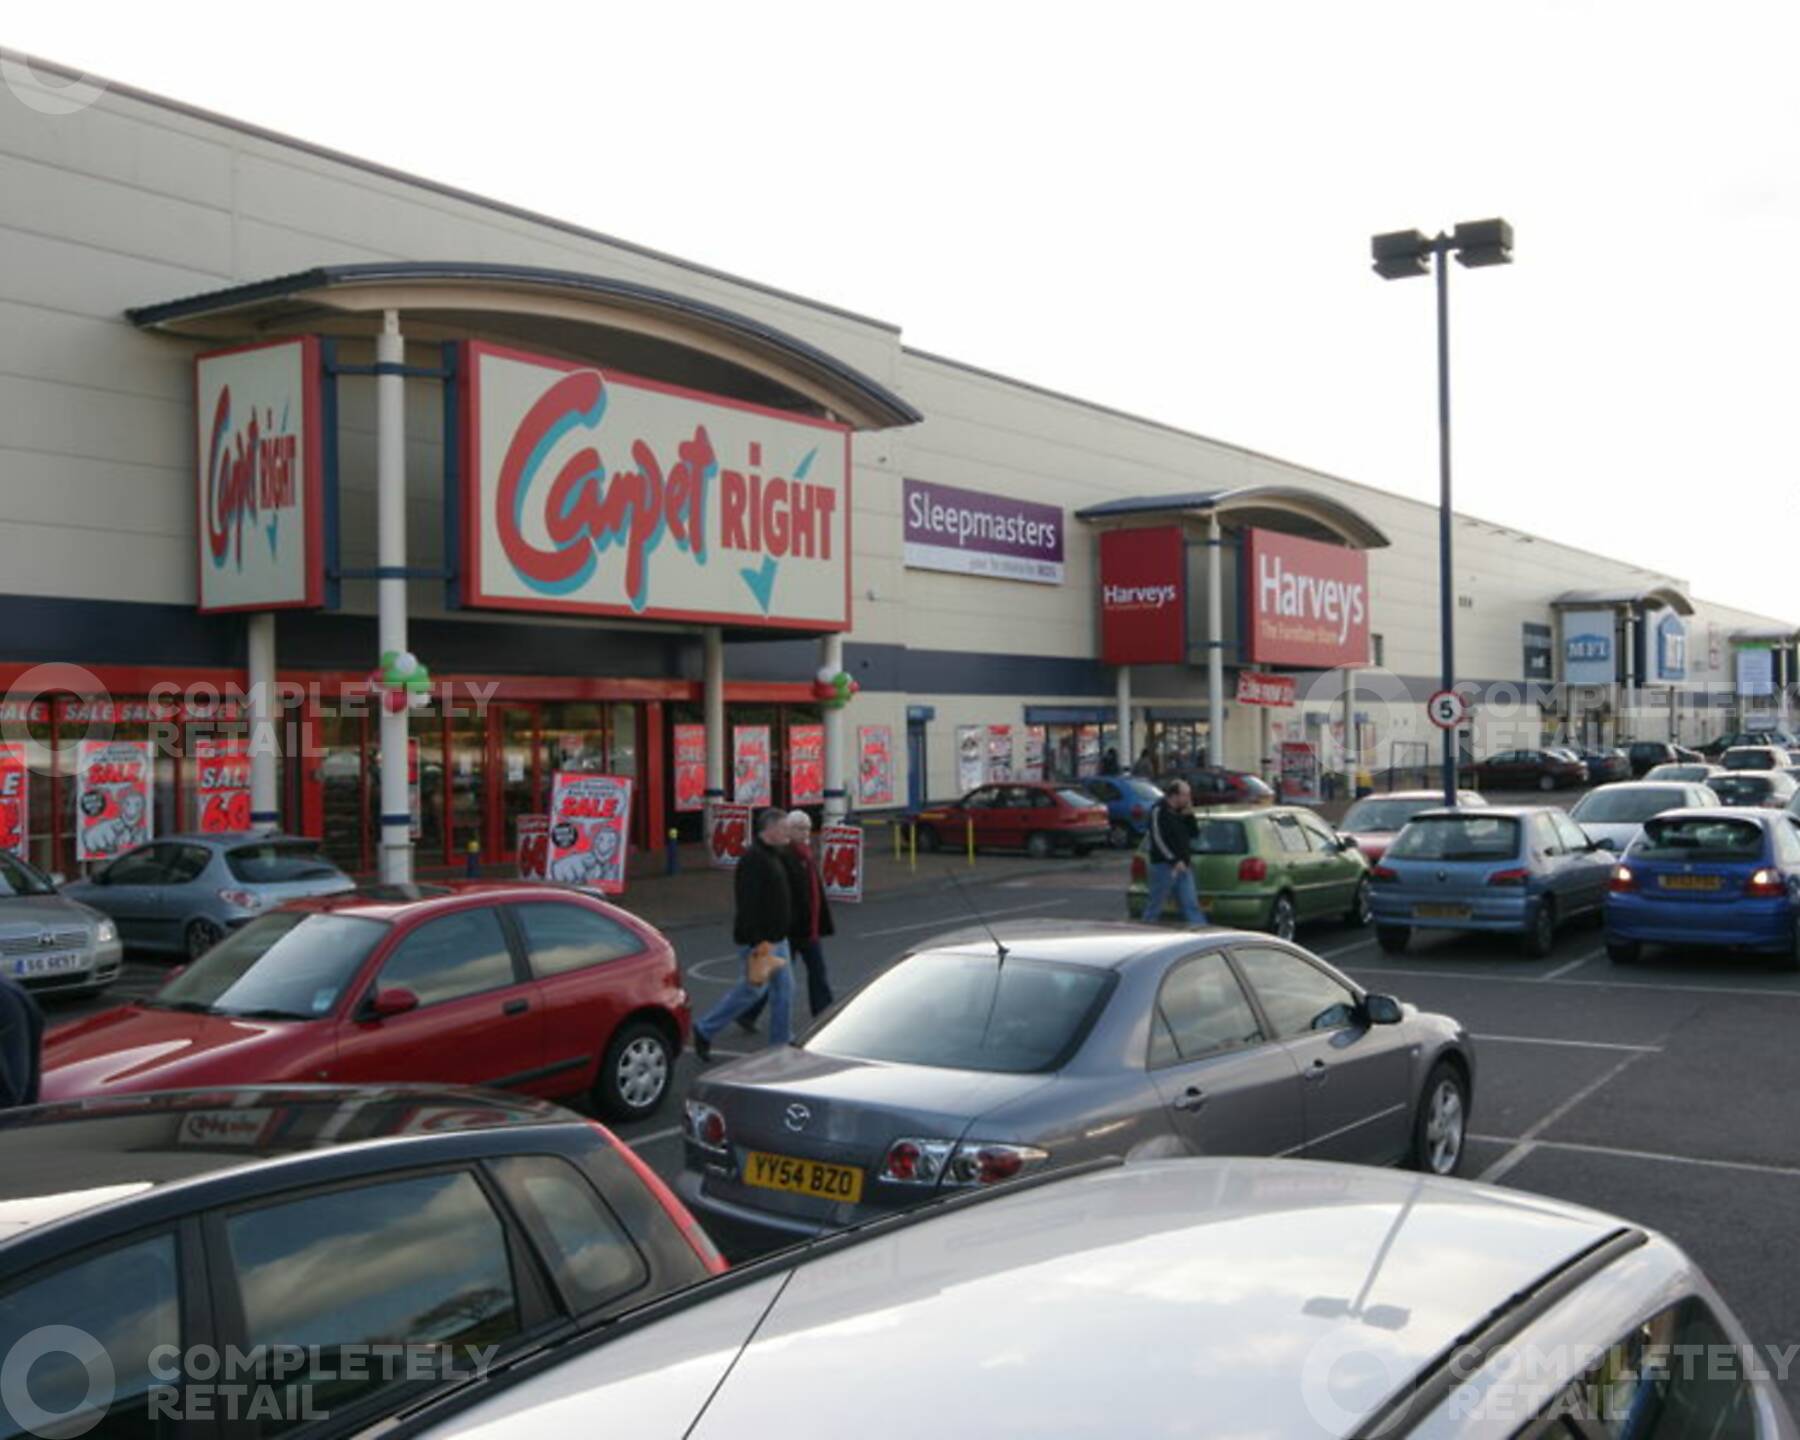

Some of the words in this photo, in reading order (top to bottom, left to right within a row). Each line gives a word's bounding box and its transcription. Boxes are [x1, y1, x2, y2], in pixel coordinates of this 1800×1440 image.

[495, 368, 718, 612] Carpet
[908, 490, 1056, 549] Sleepmasters
[1103, 584, 1176, 608] Harveys
[1259, 553, 1364, 646] Harveys
[1440, 697, 1454, 719] 5
[752, 1153, 804, 1188] YY54
